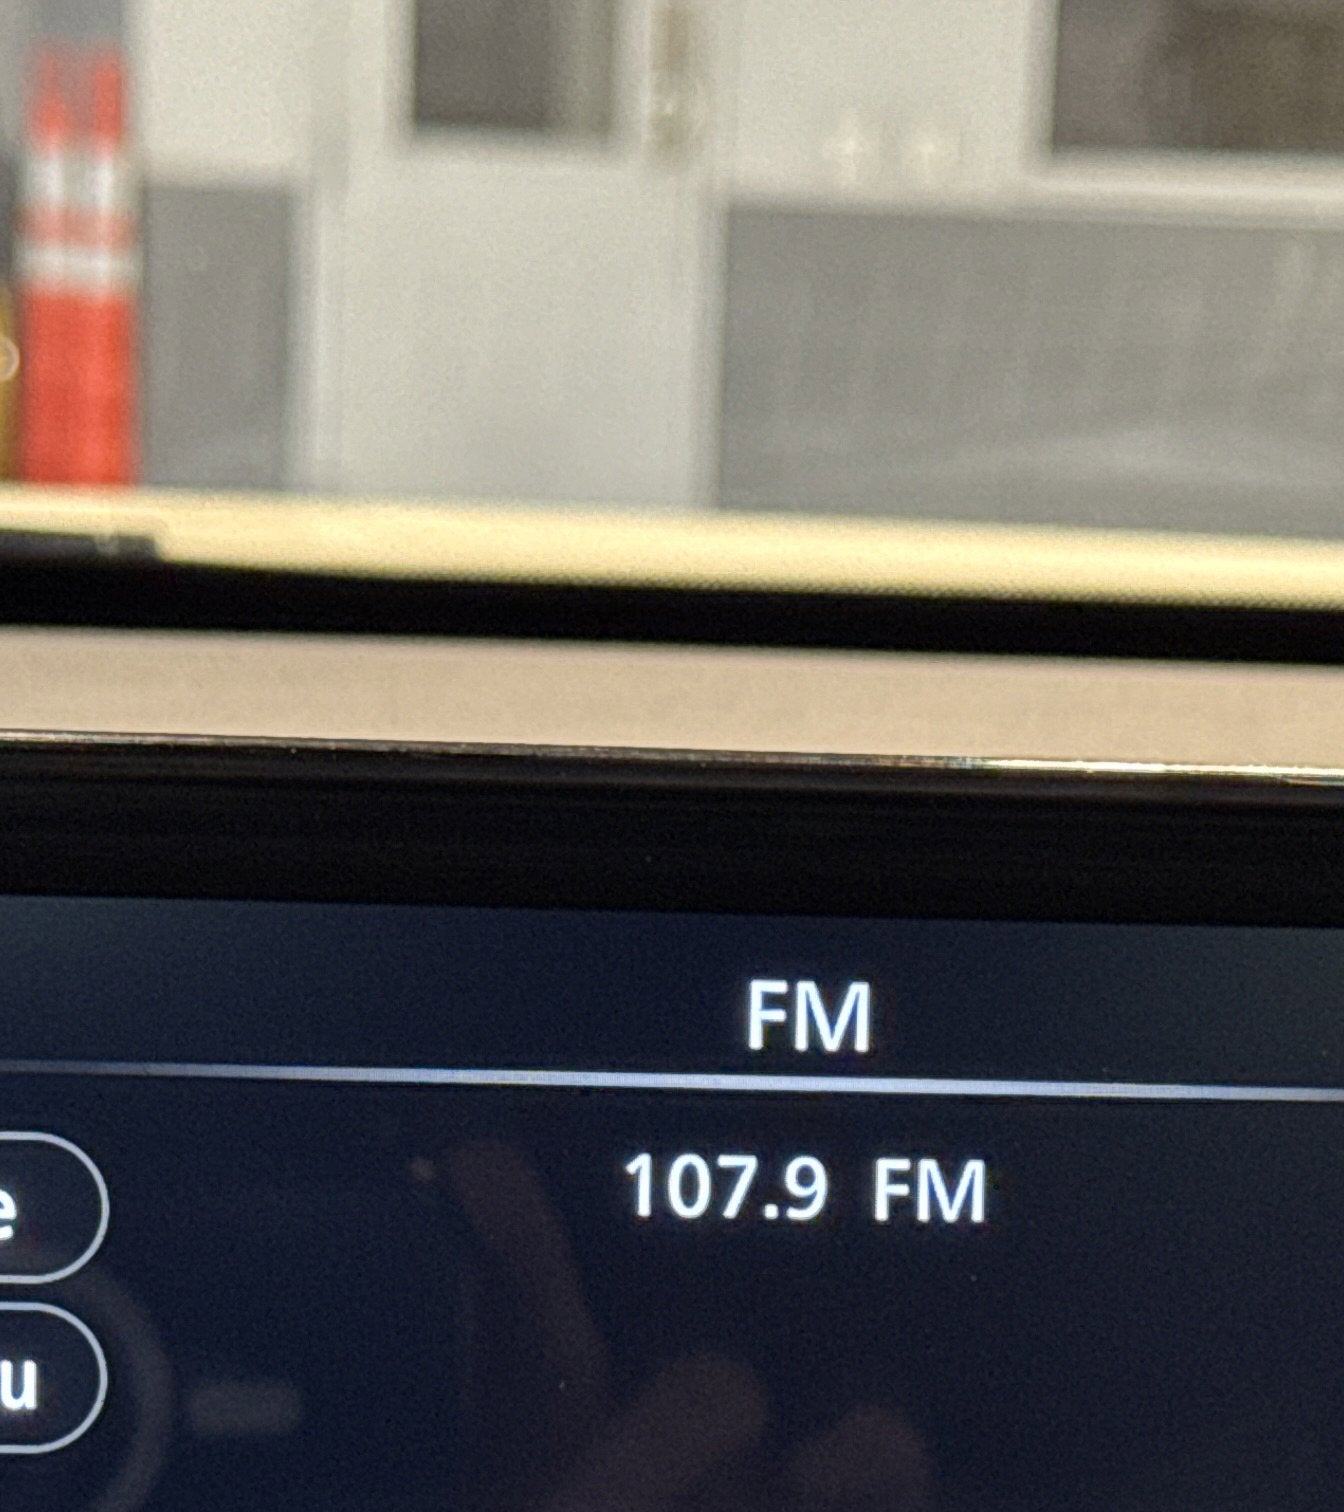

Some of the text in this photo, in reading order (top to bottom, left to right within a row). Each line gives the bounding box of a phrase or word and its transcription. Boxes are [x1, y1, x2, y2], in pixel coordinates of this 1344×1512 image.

[748, 978, 871, 1053] FM
[624, 1153, 987, 1223] 107.9 FM
